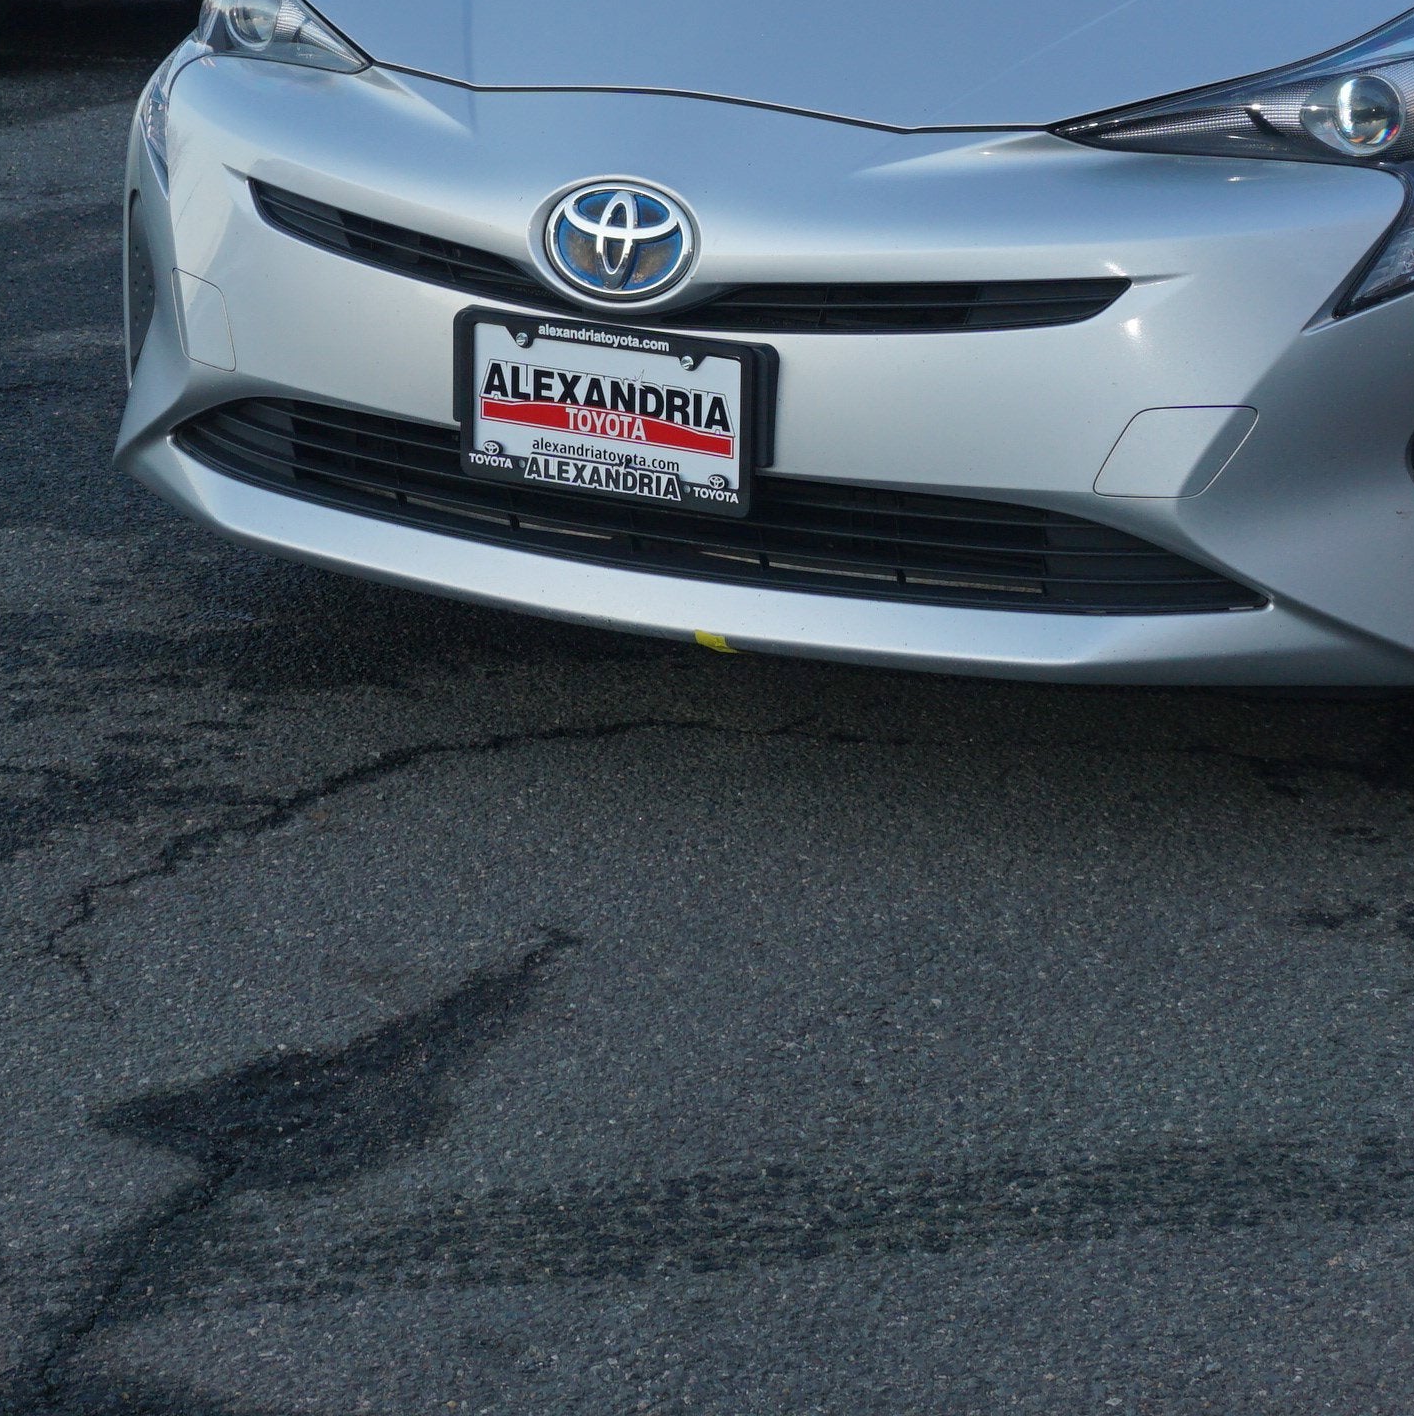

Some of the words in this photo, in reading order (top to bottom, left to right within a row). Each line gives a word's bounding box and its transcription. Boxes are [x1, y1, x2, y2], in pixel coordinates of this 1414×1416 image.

[537, 323, 670, 352] alexandriatoyota.com
[481, 361, 733, 434] ALEXANDRIA
[565, 406, 647, 441] TOYOTA
[468, 452, 513, 469] TOYOTA
[532, 437, 680, 472] alexandriatoyota.com
[525, 455, 682, 501] ALEXANDRIA
[692, 486, 739, 504] TOYOTA
